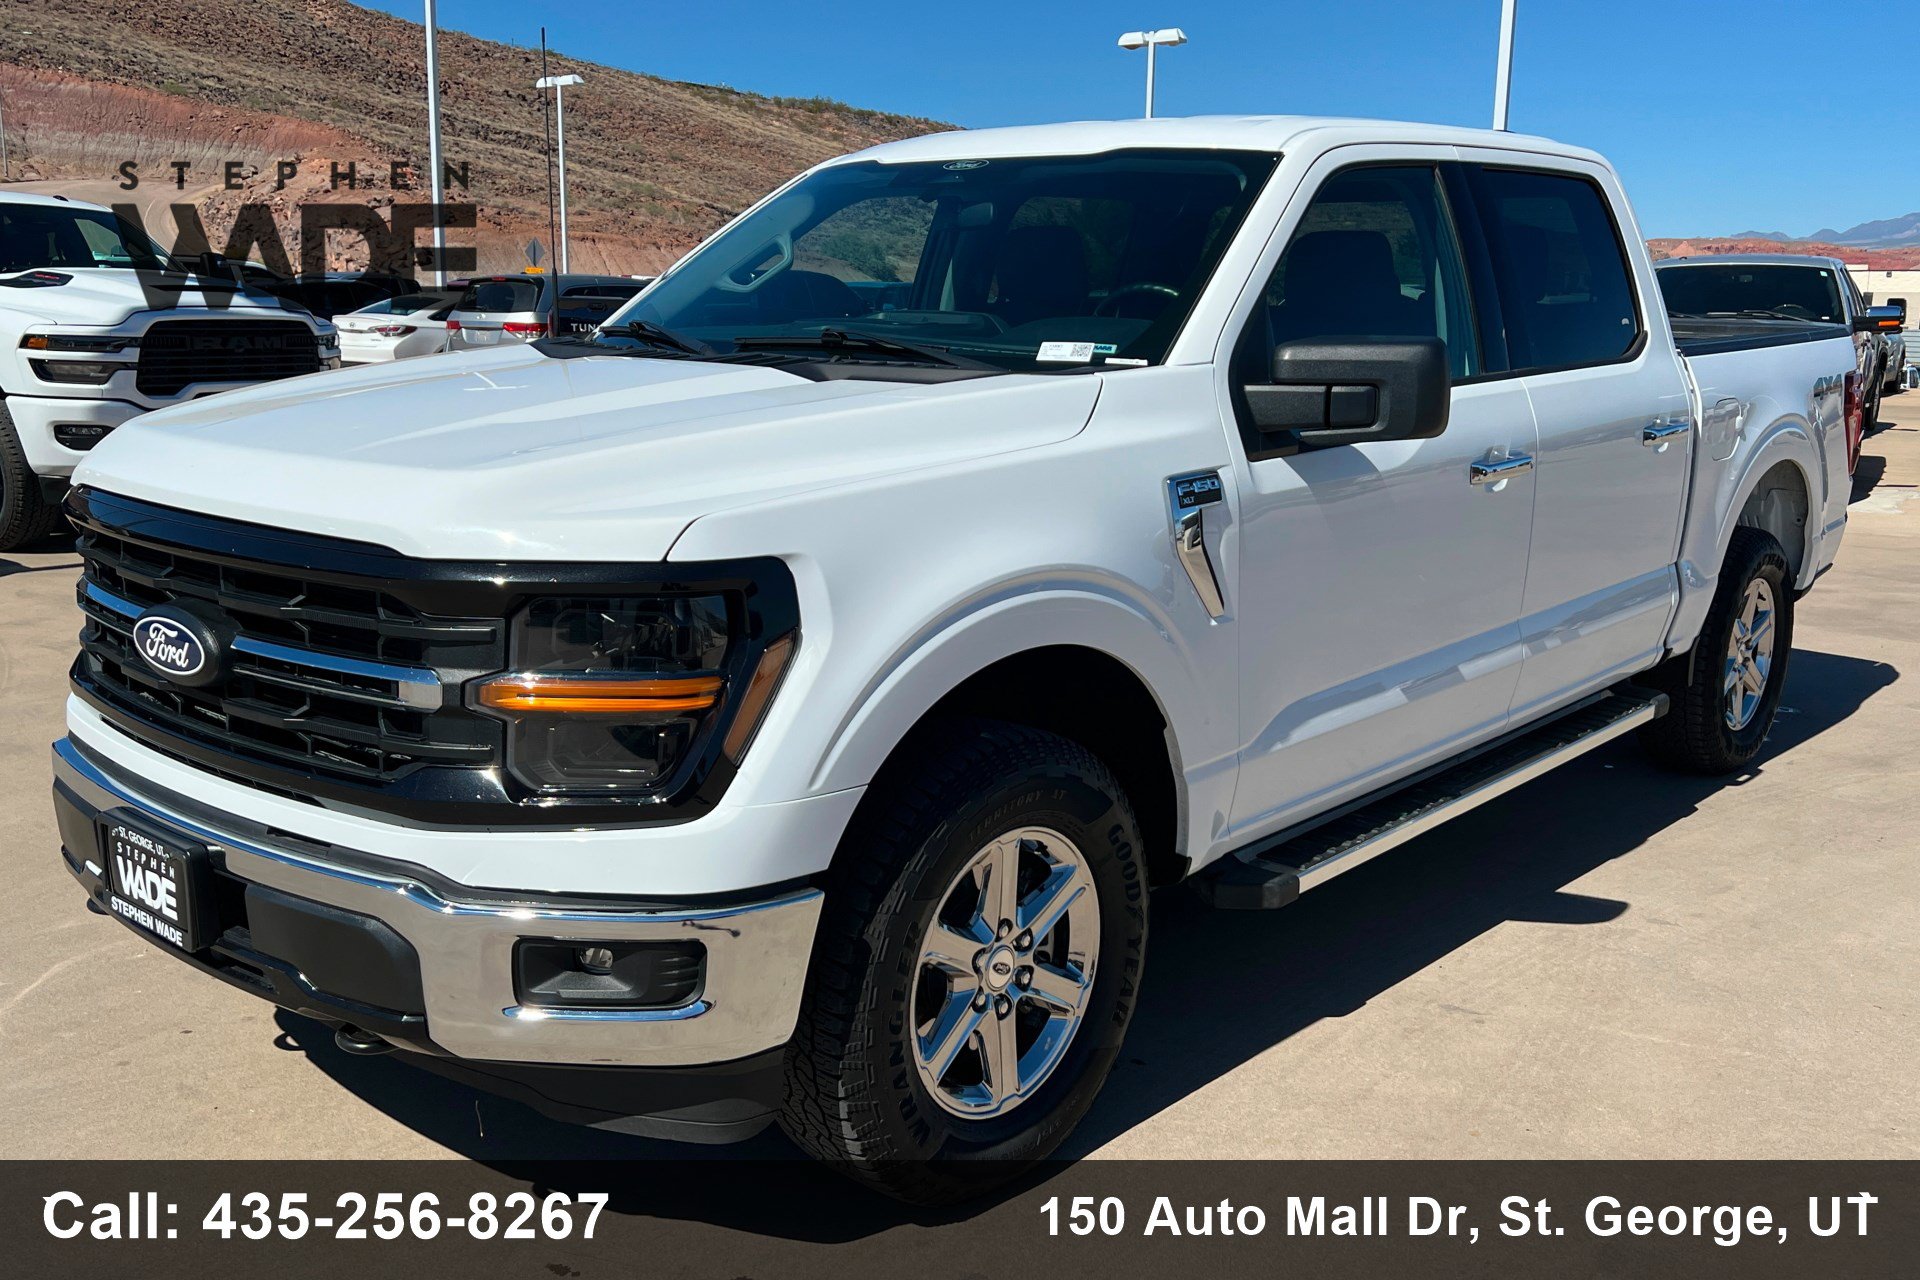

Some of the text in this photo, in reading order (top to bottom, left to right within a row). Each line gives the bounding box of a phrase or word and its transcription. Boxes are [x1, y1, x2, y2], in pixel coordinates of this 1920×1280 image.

[190, 335, 281, 351] RAM
[1178, 479, 1220, 496] F-150
[1183, 496, 1195, 504] XLT
[146, 622, 189, 668] Ford
[117, 842, 175, 879] STEPHEN
[116, 855, 178, 921] WADE
[111, 896, 183, 947] STEPHEN WADE
